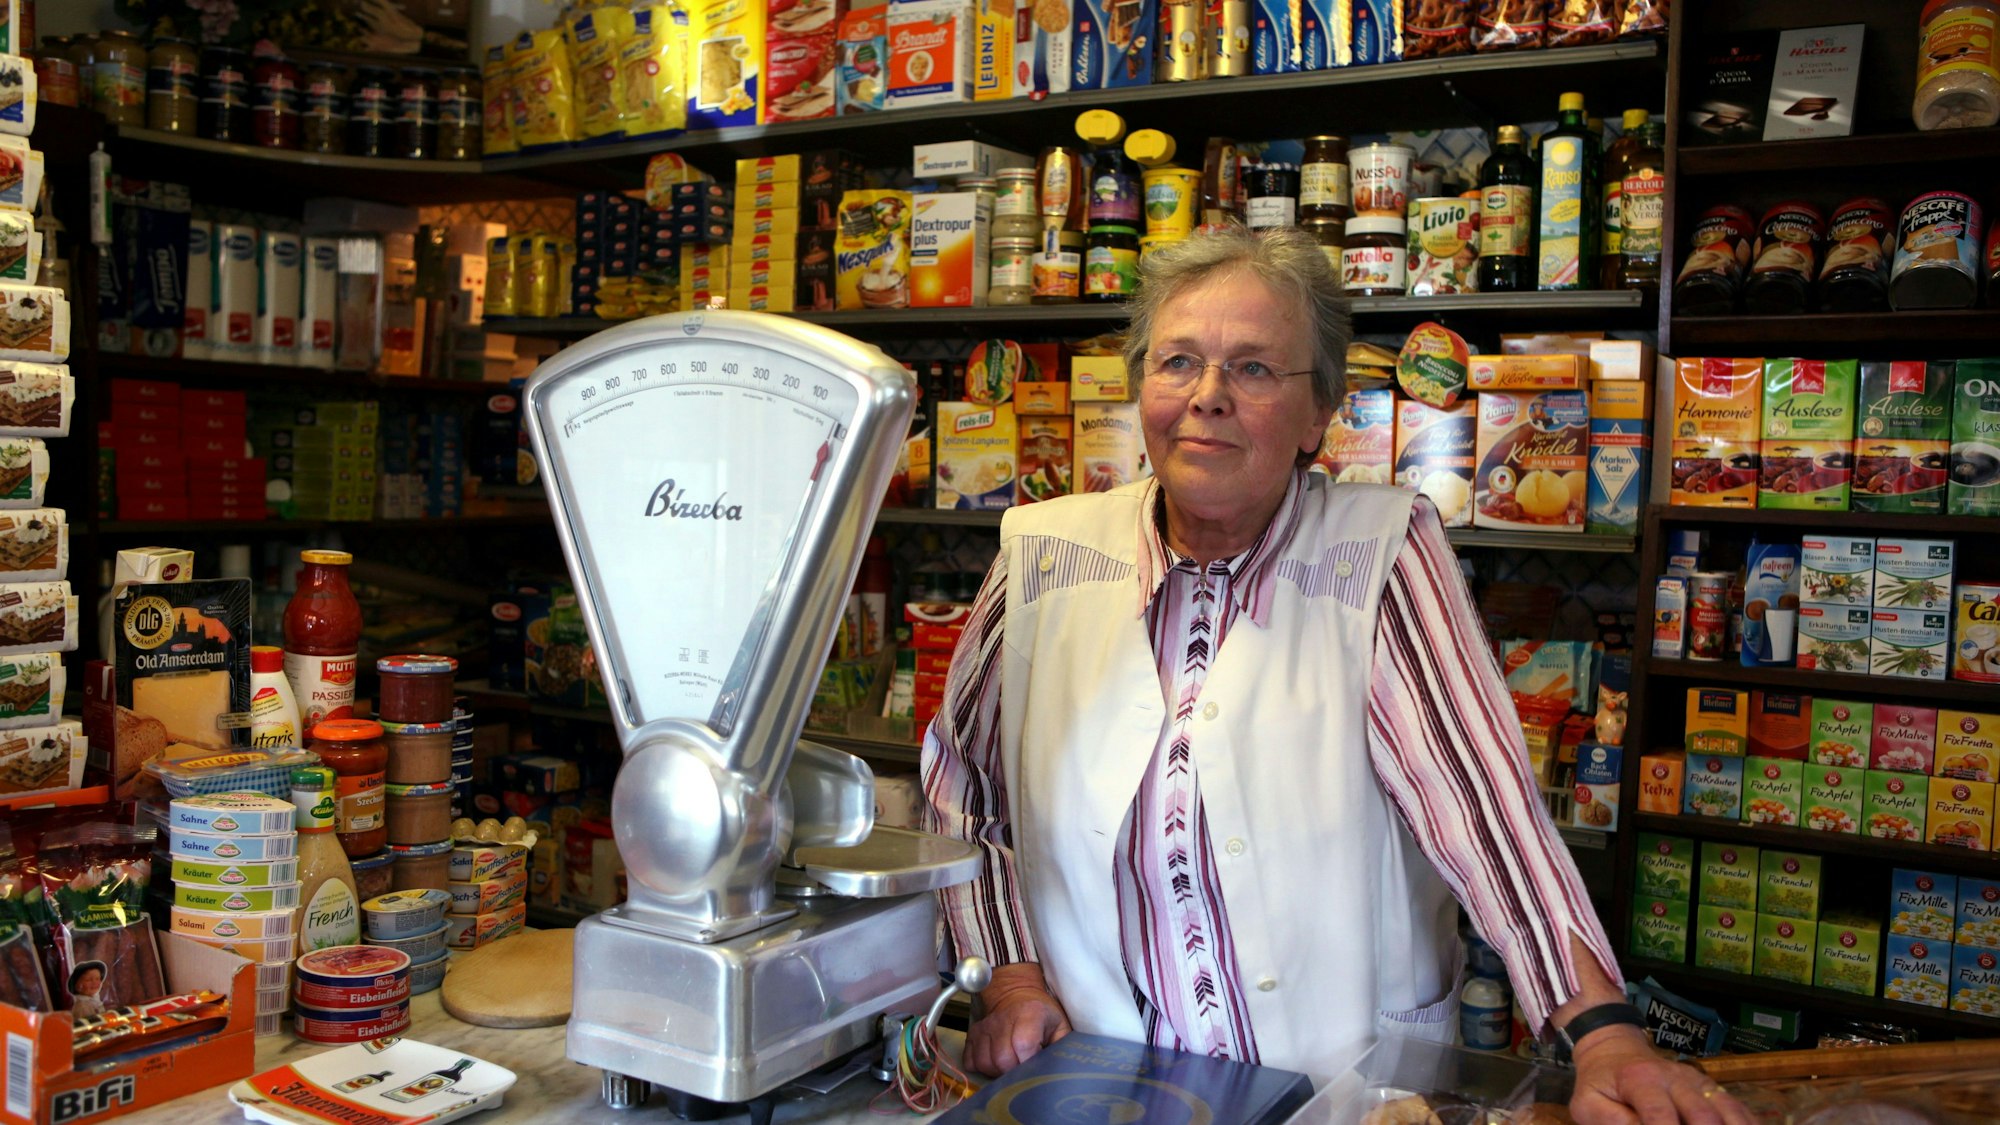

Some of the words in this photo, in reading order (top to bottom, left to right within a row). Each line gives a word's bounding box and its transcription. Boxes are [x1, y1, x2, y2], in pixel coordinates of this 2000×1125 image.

[895, 27, 948, 48] Brandt
[1357, 20, 1368, 61] Bahlsen
[978, 23, 998, 90] LEIBNIZ
[1256, 29, 1267, 70] Bahlsen
[1305, 29, 1315, 70] Bahlsen
[1789, 46, 1848, 57] HACHEZ
[1076, 34, 1091, 85] Bahlsen
[1544, 168, 1580, 190] Rapso
[914, 218, 972, 233] Dextropur
[1423, 206, 1465, 232] Livio
[914, 234, 938, 248] plus
[1344, 247, 1393, 264] nutella
[660, 363, 677, 375] 600
[691, 361, 707, 373] 500
[721, 363, 739, 375] 400
[752, 367, 770, 382] 300
[1426, 357, 1459, 379] BROCCOLI
[631, 368, 648, 382] 700
[782, 374, 801, 390] 200
[605, 376, 621, 391] 800
[581, 386, 597, 401] 900
[813, 385, 829, 401] 100
[1483, 402, 1517, 418] Pfanni
[1679, 400, 1752, 419] Harmonie
[1773, 399, 1843, 419] Auslese
[1868, 396, 1943, 416] Auslese
[959, 412, 990, 429] reis-fit
[1081, 416, 1133, 433] Mondamin
[942, 435, 1010, 448] Spitzen-Langkorn
[1504, 438, 1577, 465] Knödel
[1600, 456, 1632, 464] Marken
[1606, 464, 1624, 473] Salz
[645, 478, 743, 521] Bizerba
[1762, 560, 1792, 572] natreen
[1878, 559, 1936, 568] Husten-Bronchial
[152, 598, 168, 614] PREIS
[139, 605, 159, 630] DLG
[131, 633, 166, 645] PRÄMIERT
[1874, 626, 1932, 637] Husten-Bronchial
[136, 654, 158, 669] Old
[159, 651, 225, 668] Amsterdam
[312, 690, 354, 701] PASSIER
[1818, 722, 1862, 736] FixApfel
[1879, 727, 1928, 741] FixMalve
[1944, 734, 1994, 749] FixFrutta
[186, 752, 260, 769] MILKANA
[1584, 768, 1612, 777] Oblaten
[1690, 773, 1737, 787] FixKräuter
[1577, 789, 1589, 798] 50
[1751, 780, 1793, 795] FixApfel
[1810, 787, 1854, 801] FixApfel
[1872, 794, 1917, 809] FixApfel
[1935, 801, 1985, 817] FixFrutta
[313, 806, 335, 816] Kühn
[181, 814, 208, 825] Sahne
[181, 840, 210, 852] Sahne
[183, 867, 212, 879] Kräuter
[1707, 865, 1750, 880] FixFenchel
[1768, 874, 1813, 889] FixFenchel
[186, 894, 217, 905] Kräuter
[308, 900, 354, 930] French
[178, 918, 206, 930] Salami
[1704, 928, 1749, 943] FixFenchel
[1762, 937, 1807, 953] FixFenchel
[1823, 947, 1871, 964] FixFenchel
[350, 984, 410, 1004] Eisbeinfleisch
[52, 1076, 135, 1125] BiFi
